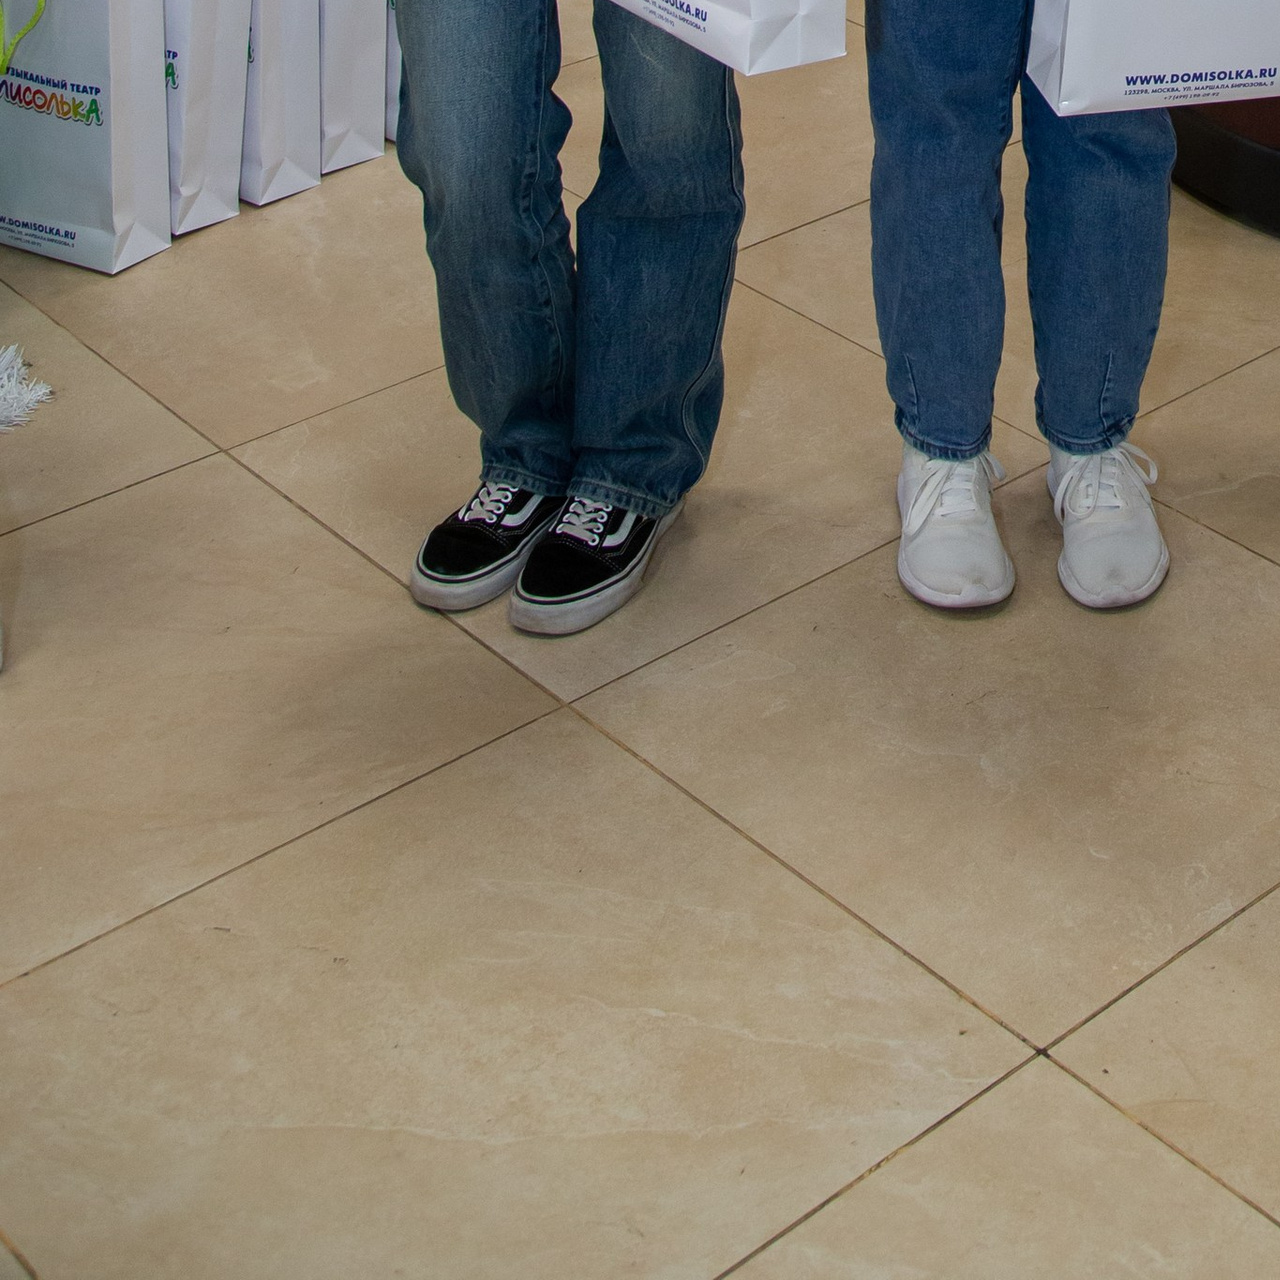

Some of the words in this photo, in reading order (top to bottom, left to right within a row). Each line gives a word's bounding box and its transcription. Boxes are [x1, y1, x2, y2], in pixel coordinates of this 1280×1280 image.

[7, 66, 68, 91] УЗЫКАЛЬНЫЙ
[70, 83, 101, 96] ТЕАТР
[1125, 67, 1277, 86] WWW.DOMISOLKA.RU
[1194, 83, 1229, 91] МАРШАЛА
[1230, 81, 1268, 89] БИРЮЗОВА,
